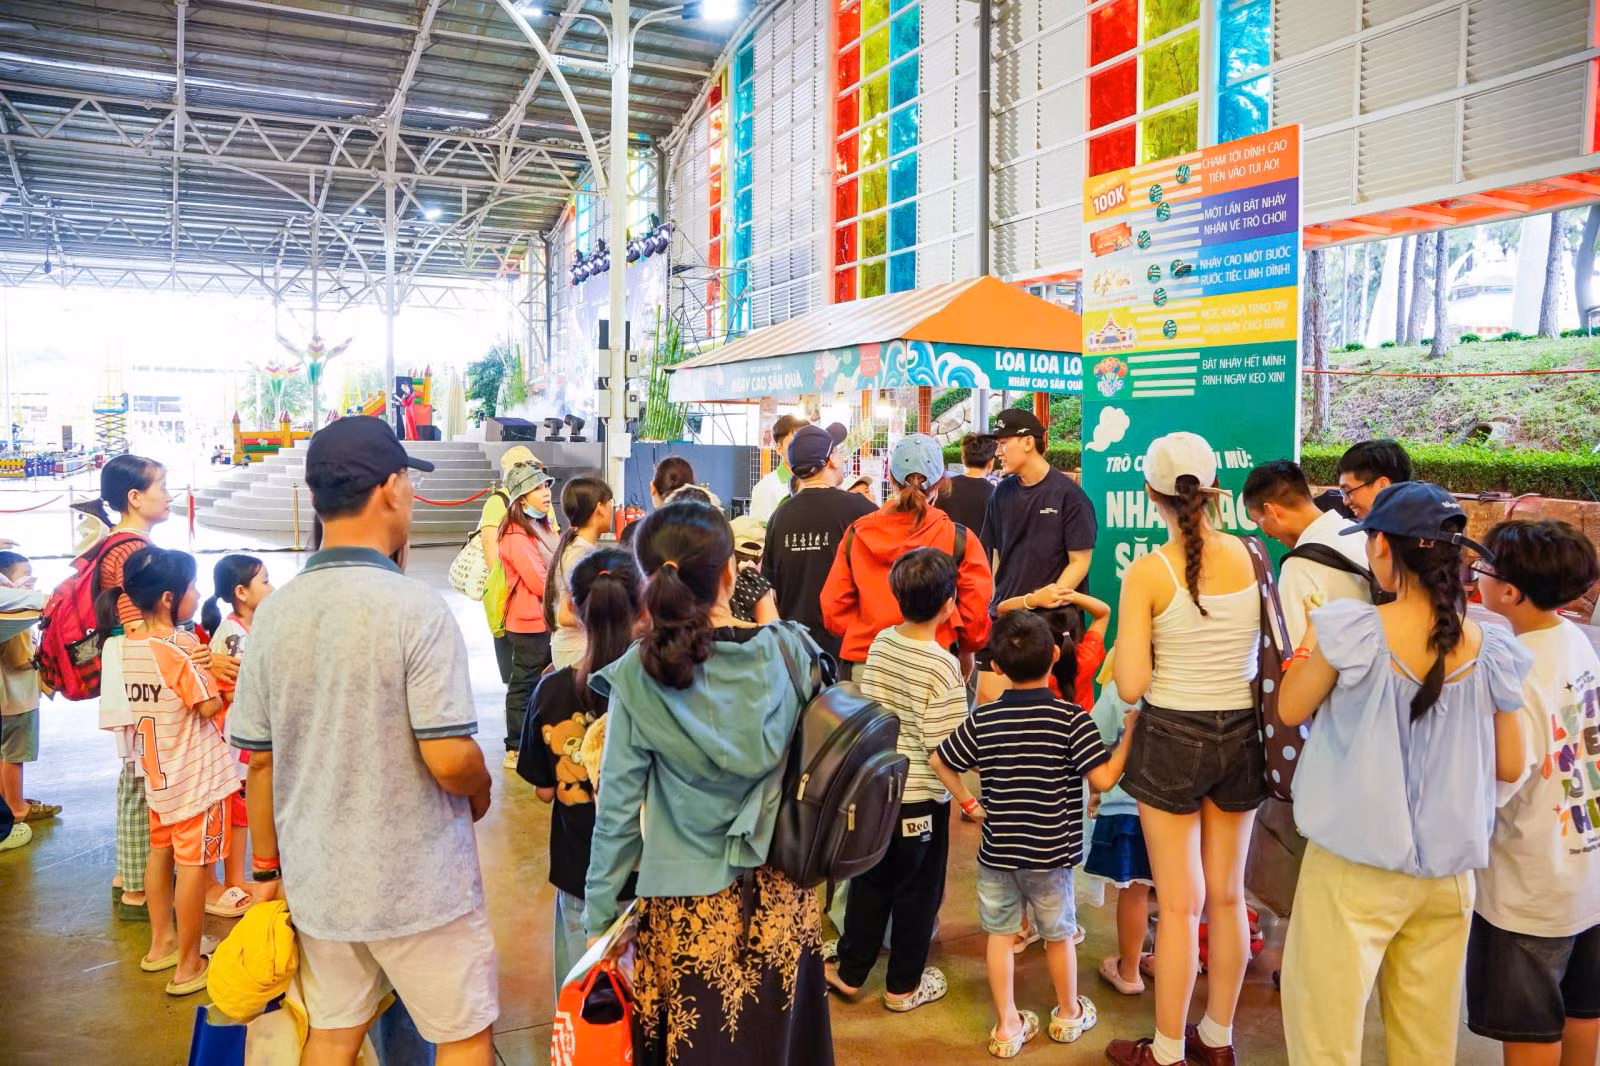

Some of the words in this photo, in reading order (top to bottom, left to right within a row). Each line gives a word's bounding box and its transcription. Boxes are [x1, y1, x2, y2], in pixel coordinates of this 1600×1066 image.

[1267, 139, 1288, 154] CAO
[1093, 184, 1126, 214] 100K
[1223, 253, 1243, 267] CAO
[1243, 266, 1264, 281] LINH
[995, 350, 1026, 373] LOA
[1029, 353, 1060, 375] LOA
[1063, 356, 1084, 377] LO
[751, 374, 767, 392] CAO
[1032, 377, 1048, 389] CAO
[1202, 374, 1222, 387] RINH
[1223, 373, 1247, 386] NGAY
[1106, 452, 1131, 472] TRÒ
[1106, 490, 1168, 528] NHA
